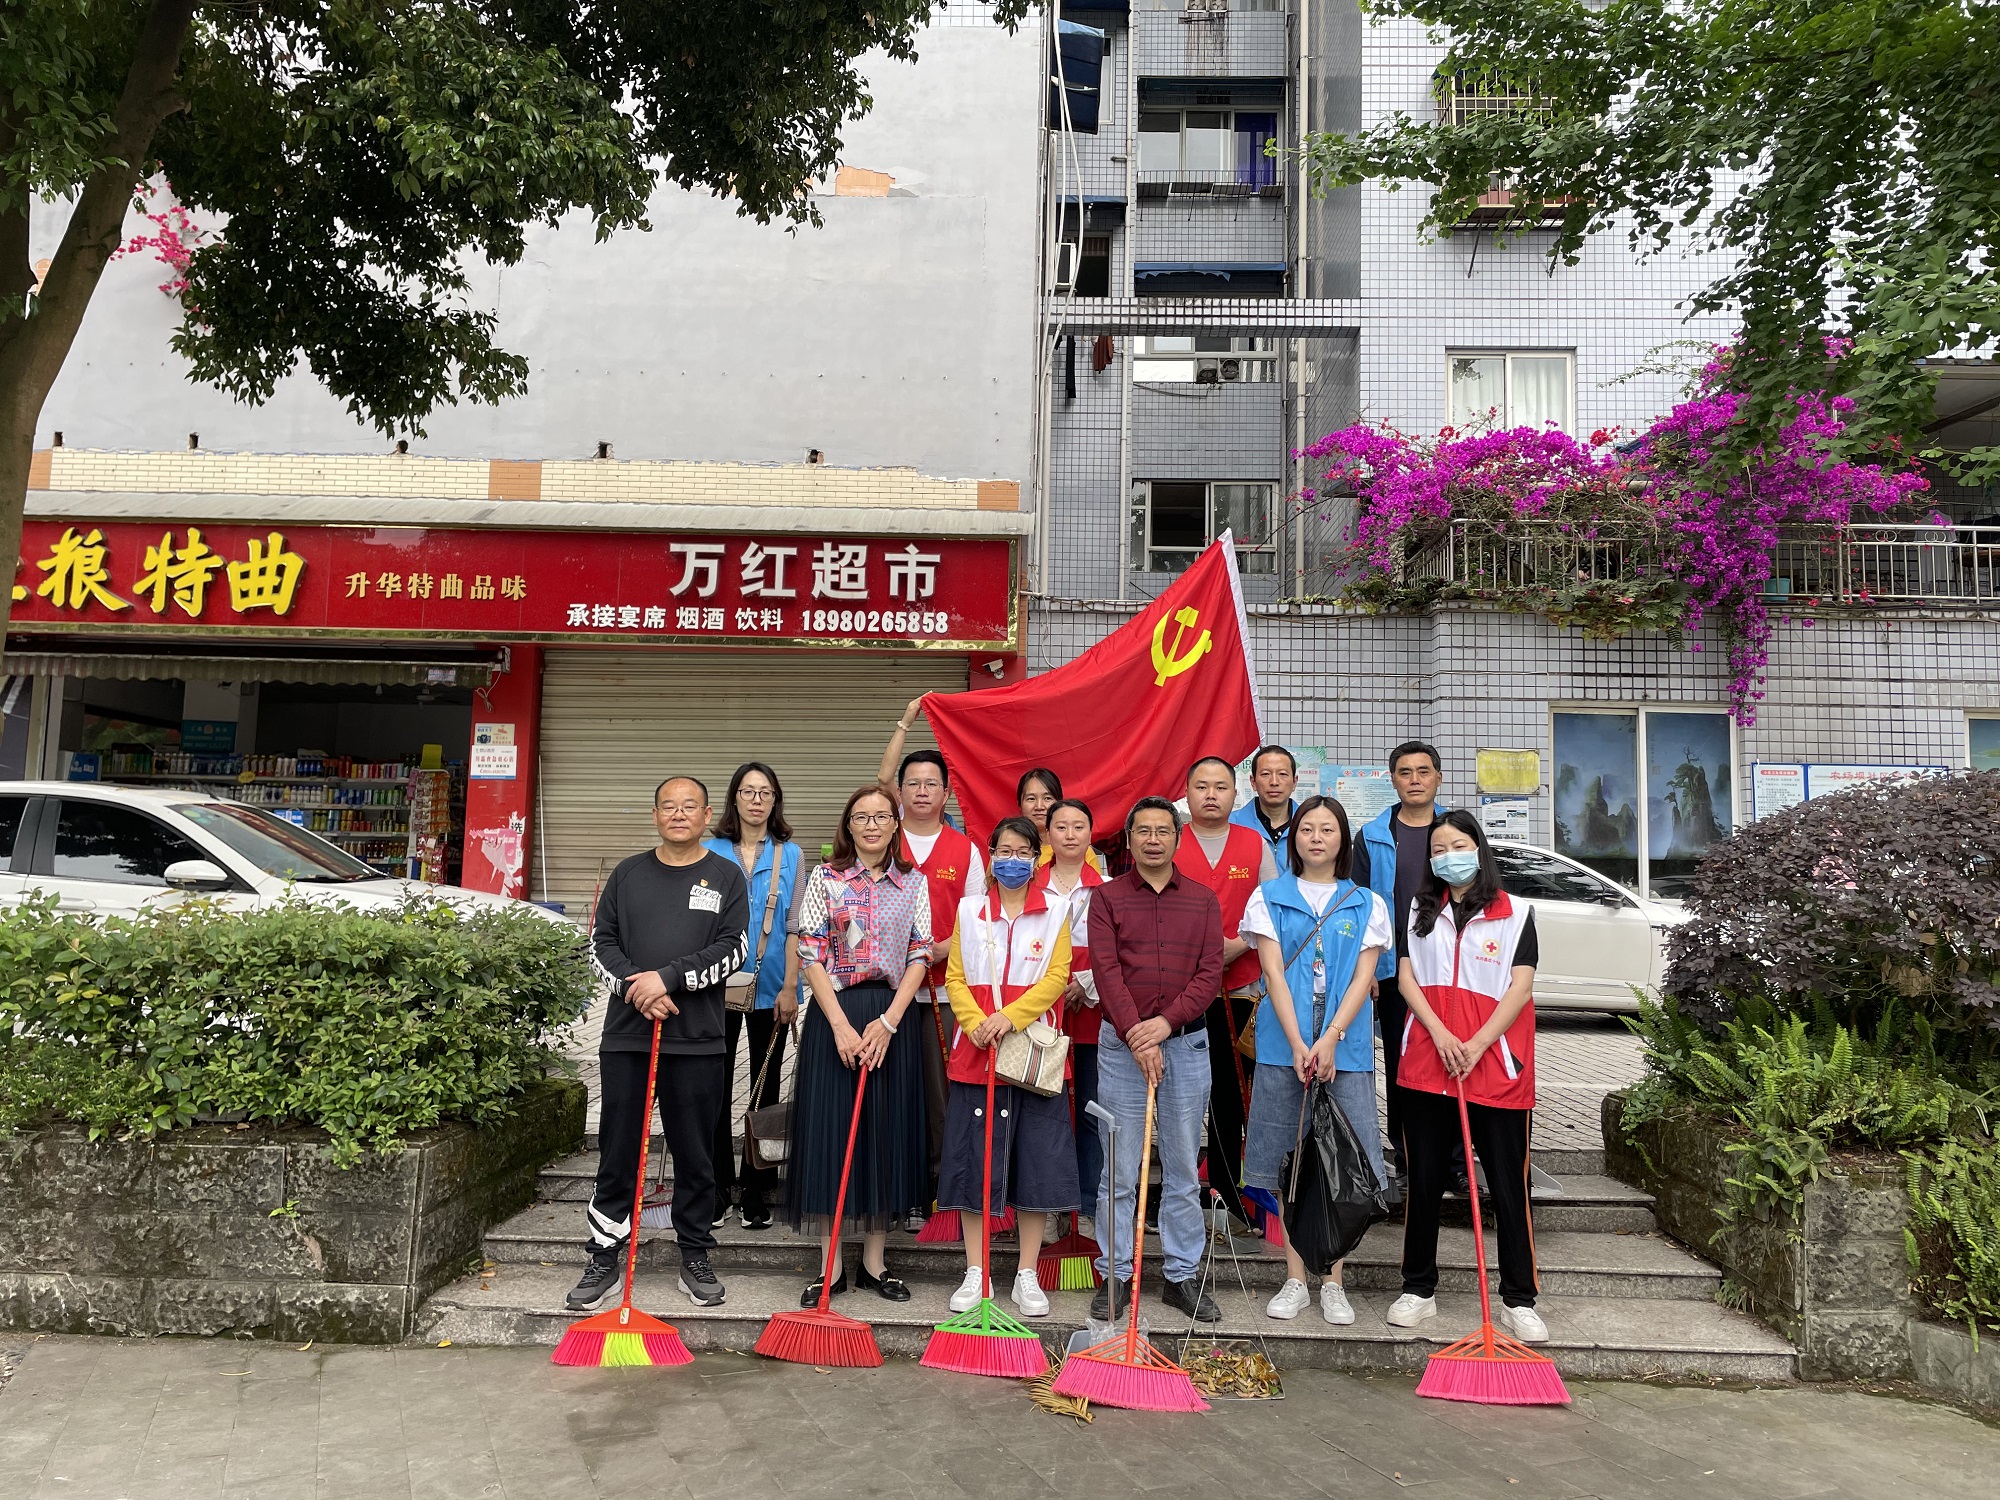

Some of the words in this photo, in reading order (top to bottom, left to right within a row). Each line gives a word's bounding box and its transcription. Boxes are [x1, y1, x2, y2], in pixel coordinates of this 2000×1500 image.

[12, 526, 306, 618] 粮特曲
[344, 571, 528, 601] 升华特曲品味
[669, 541, 941, 603] 万红超市
[566, 604, 666, 630] 承接宴席
[675, 606, 725, 631] 烟酒
[735, 607, 784, 632] 饮料
[802, 609, 949, 634] 18980265858
